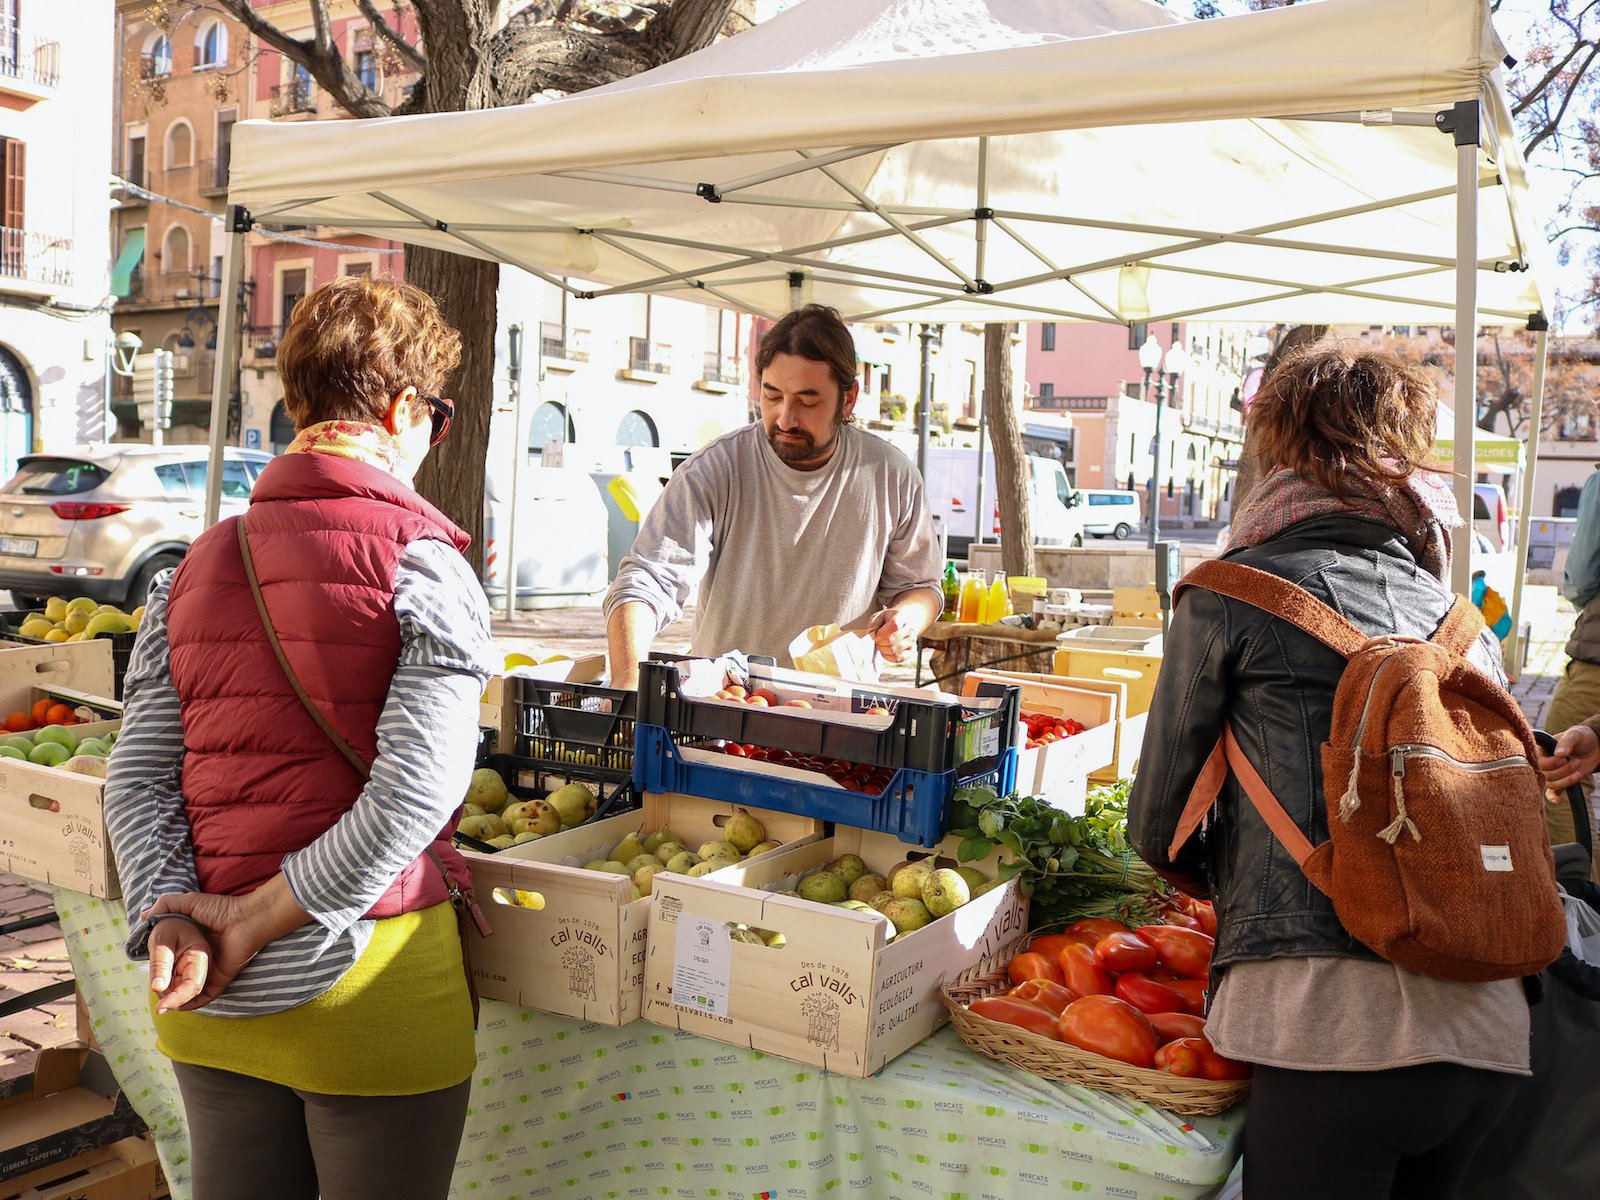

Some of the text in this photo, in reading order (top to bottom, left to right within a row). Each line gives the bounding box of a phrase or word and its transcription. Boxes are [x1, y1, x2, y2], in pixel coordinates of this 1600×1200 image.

[248, 431, 257, 445] P
[62, 822, 96, 844] cal valls
[584, 920, 599, 931] 1978
[995, 901, 1024, 941] valls
[551, 927, 607, 955] cal valls
[694, 955, 709, 964] PERA
[831, 965, 849, 979] 1978
[881, 960, 924, 992] AGRICULTURA
[632, 973, 643, 986] DE
[790, 972, 857, 1005] cal valls
[879, 986, 913, 1014] ECOLÒGICA
[655, 999, 734, 1025] www.calvalls.com
[486, 1019, 506, 1028] MERCATS
[877, 1002, 919, 1037] DE QUALITAT
[521, 1037, 542, 1047] MERCATS
[615, 1039, 637, 1049] MERCATS
[560, 1054, 582, 1064] MERCATS
[503, 1070, 523, 1079] MERCATS
[597, 1070, 621, 1082] MERCATS
[540, 1086, 562, 1096] MERCATS
[638, 1088, 660, 1097] MERCATS
[484, 1100, 505, 1109] MERCATS
[580, 1101, 602, 1112] MERCATS
[1017, 1110, 1048, 1120] MERCATS
[523, 1117, 544, 1126] MERCATS
[468, 1131, 488, 1139] MERCATS
[562, 1131, 585, 1141] MERCATS
[770, 1132, 796, 1140] MERCATS
[1108, 1131, 1140, 1142] MERCATS
[978, 1136, 1006, 1145] MERCATS
[506, 1146, 526, 1155] MERCATS
[606, 1142, 626, 1151] MERCATS
[876, 1145, 898, 1155] MERCATS
[2, 1160, 29, 1173] LLORENS
[30, 1147, 62, 1163] CAPDEVILA
[1062, 1150, 1093, 1160] MERCATS
[546, 1159, 568, 1169] MERCATS
[808, 1154, 833, 1167] MERCATS
[490, 1174, 510, 1183] MERCATS
[588, 1169, 610, 1178] MERCATS
[1020, 1172, 1048, 1182] MERCATS
[1154, 1171, 1190, 1184] MERCATS
[849, 1176, 872, 1186] MERCATS
[912, 1180, 933, 1191] MERCATS
[529, 1186, 551, 1196] MERCATS
[1106, 1186, 1137, 1196] MERCATS
